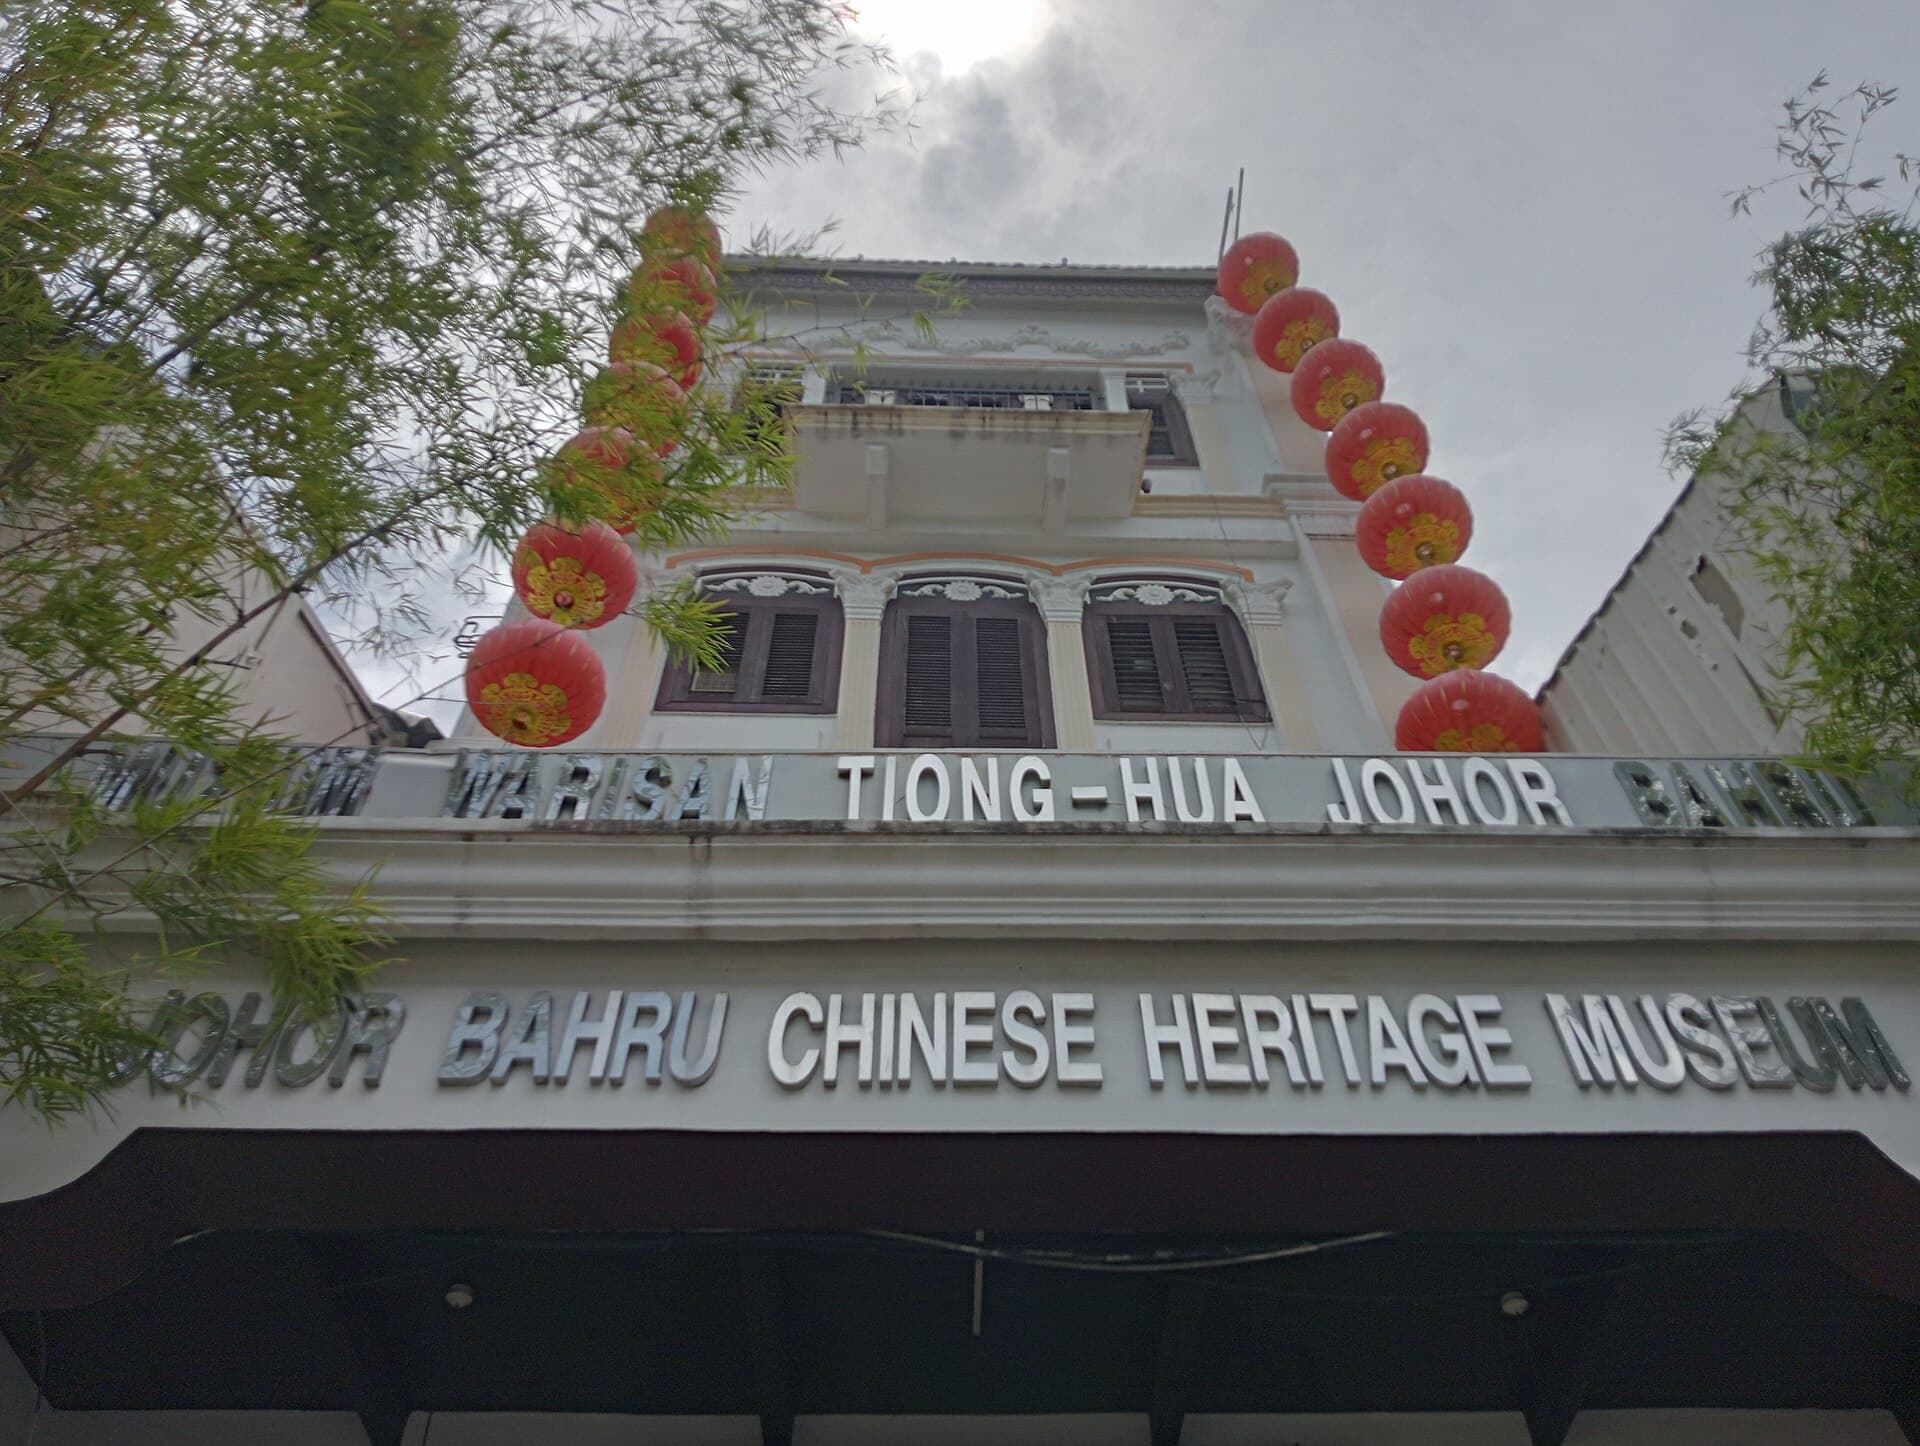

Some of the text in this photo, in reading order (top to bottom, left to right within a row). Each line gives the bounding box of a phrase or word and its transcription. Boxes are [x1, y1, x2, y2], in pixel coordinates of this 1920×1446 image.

[443, 746, 773, 822] WARISAN
[1326, 756, 1575, 826] JOHOR
[1613, 760, 1877, 828] BAHRU
[437, 989, 729, 1088] BAHRU
[767, 989, 1103, 1090] CHINESE
[1139, 992, 1532, 1090] HERITAGE
[1543, 992, 1912, 1093] MUSEUM
